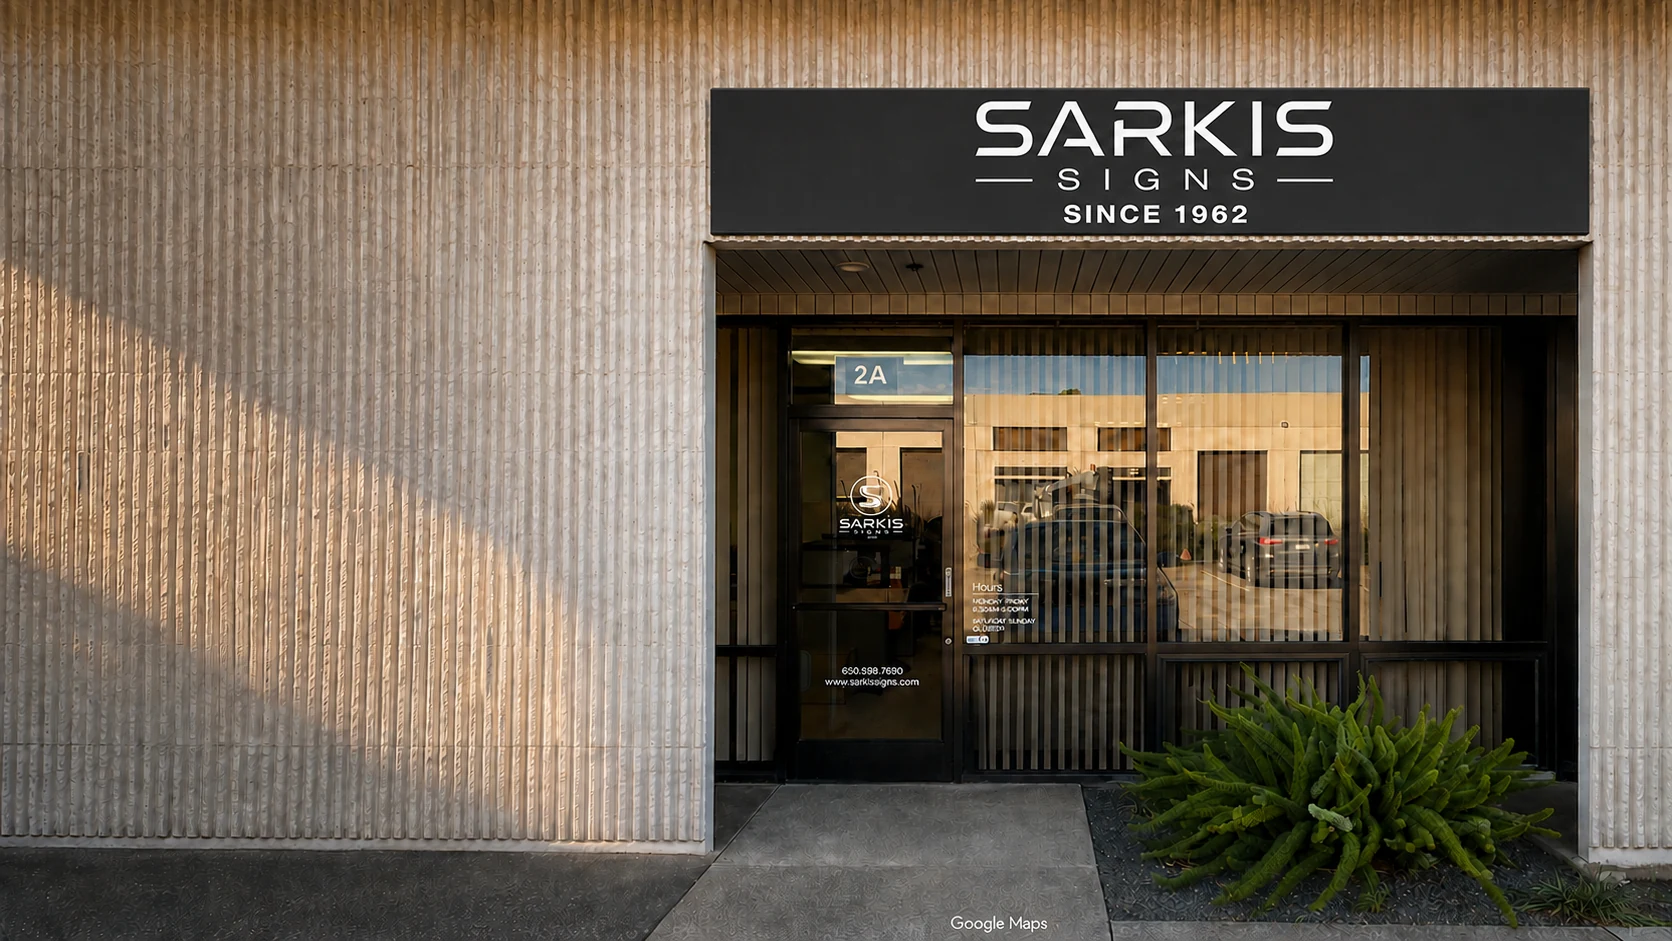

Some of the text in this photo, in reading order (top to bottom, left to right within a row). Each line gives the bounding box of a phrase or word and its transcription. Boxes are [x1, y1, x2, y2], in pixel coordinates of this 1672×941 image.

[975, 101, 1334, 156] SARKIS
[1057, 168, 1256, 191] SIGNS
[1063, 204, 1248, 224] SINCE 1962
[854, 365, 887, 385] 2A
[839, 517, 904, 529] SARKIS
[972, 583, 1003, 592] Hours
